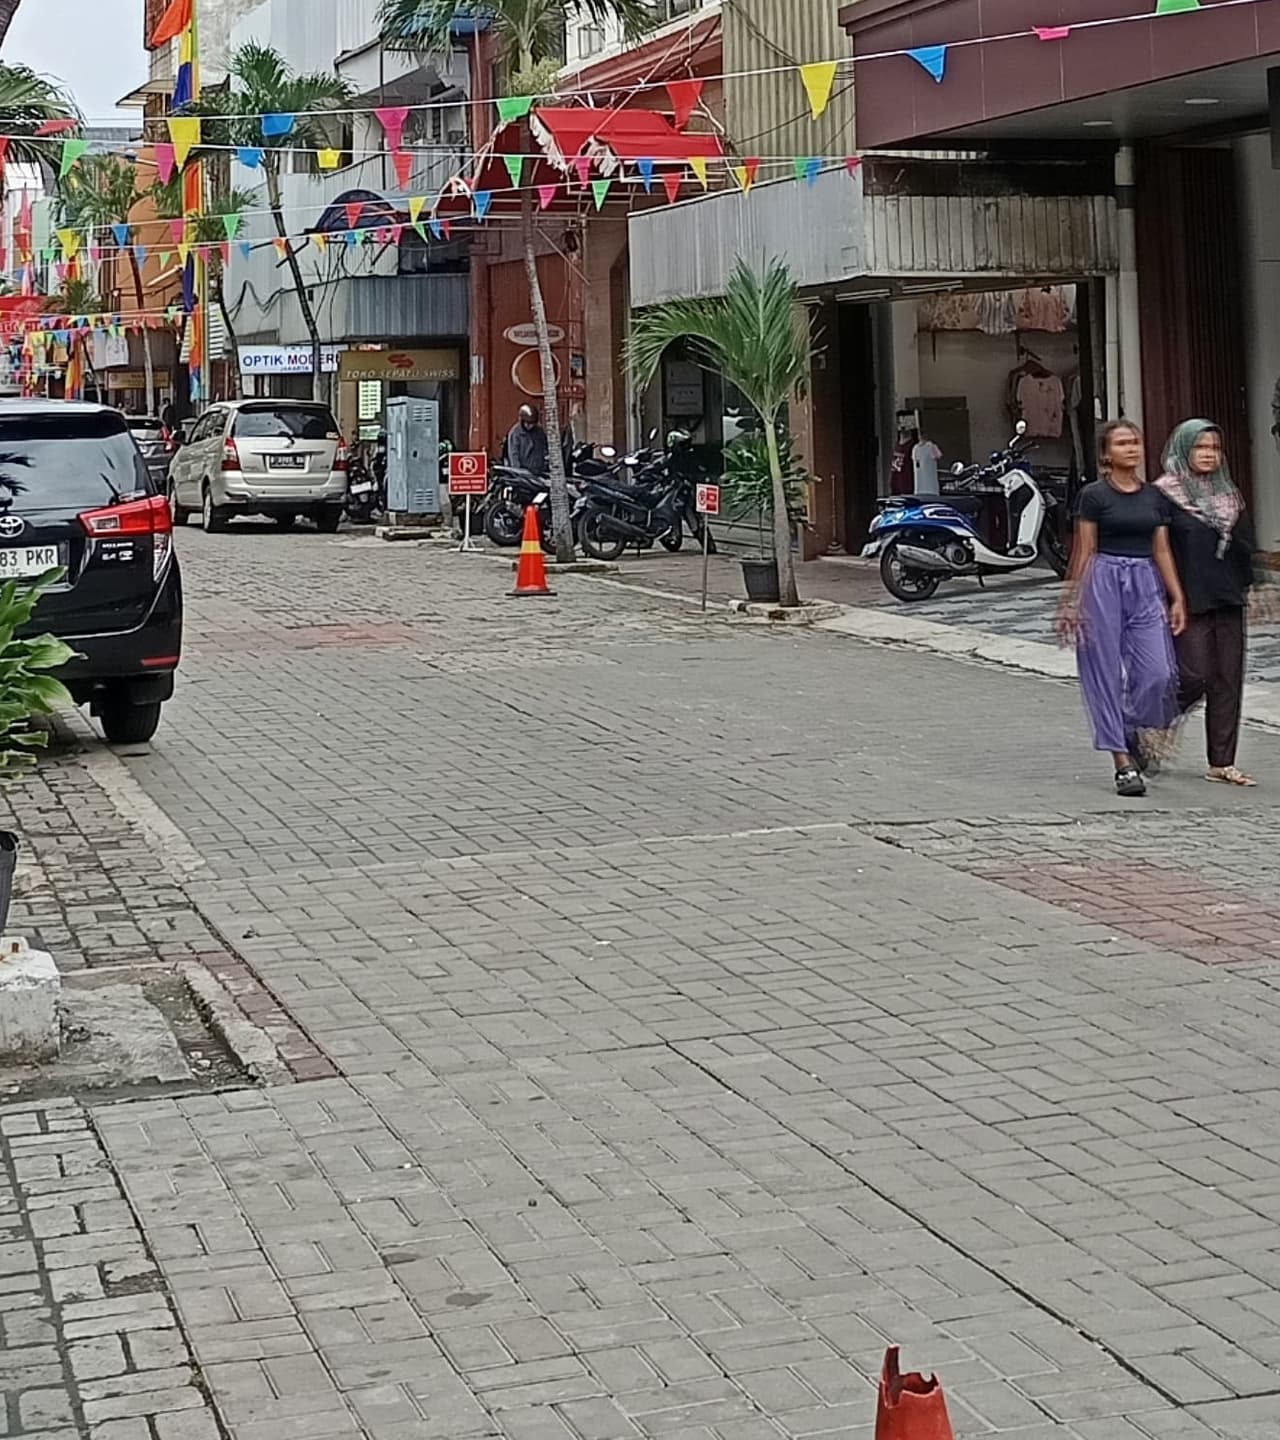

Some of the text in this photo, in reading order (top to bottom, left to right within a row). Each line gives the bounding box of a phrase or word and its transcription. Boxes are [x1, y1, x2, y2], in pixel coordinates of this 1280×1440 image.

[242, 355, 283, 367] OPTIK
[345, 369, 376, 379] TOKO
[423, 368, 455, 378] SWISS
[26, 547, 55, 566] PKR
